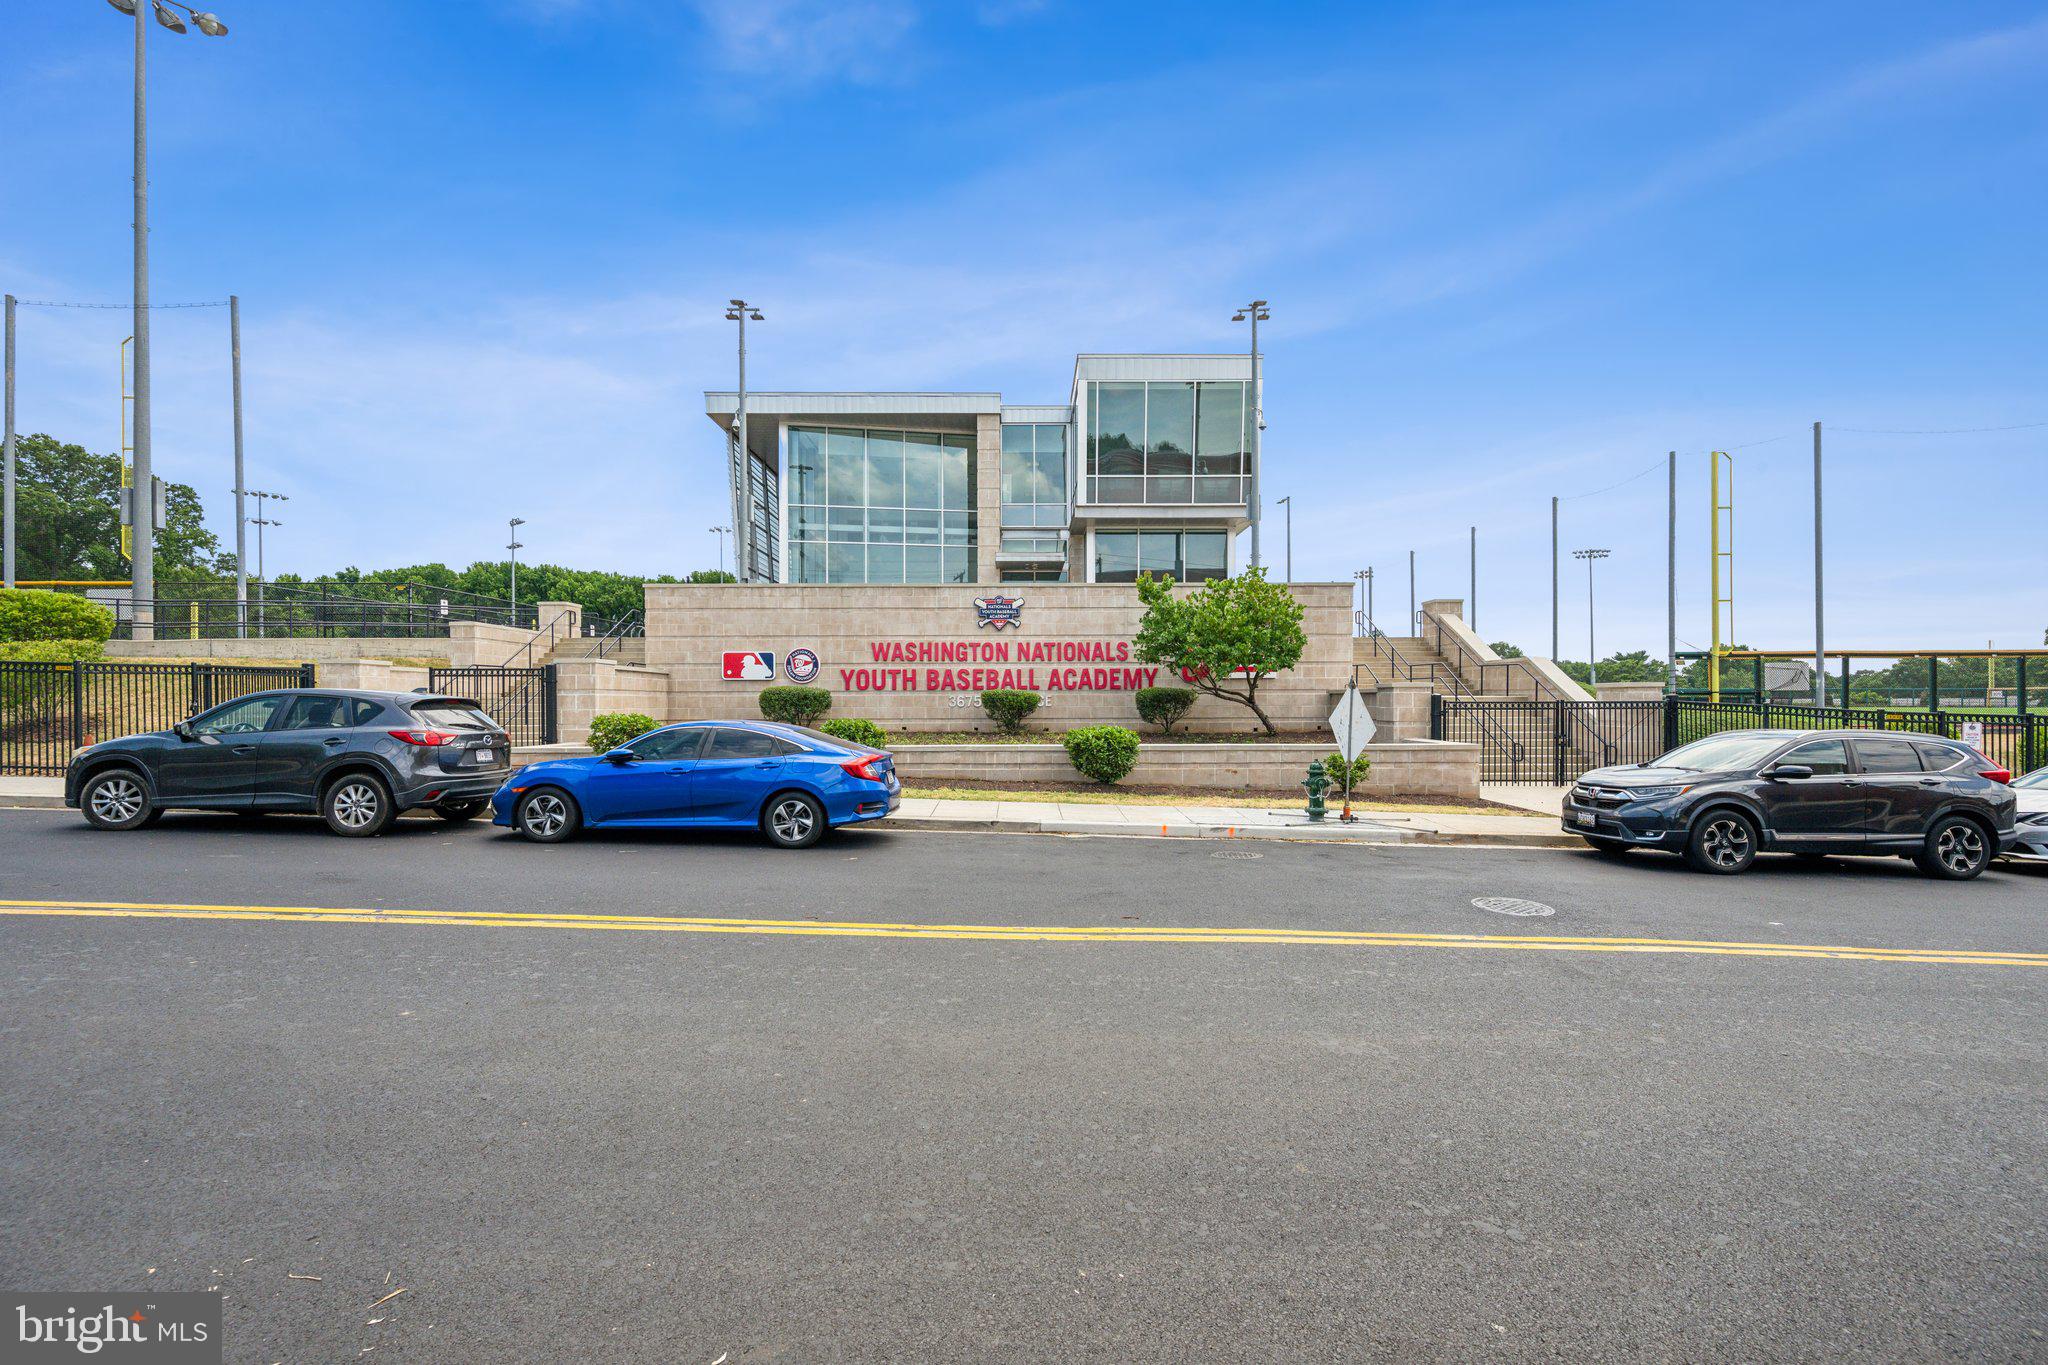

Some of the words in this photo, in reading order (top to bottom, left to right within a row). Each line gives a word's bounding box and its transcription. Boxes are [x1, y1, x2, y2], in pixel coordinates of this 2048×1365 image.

[872, 642, 1008, 662] WASHINGTON
[1018, 642, 1128, 662] NATIONALS
[840, 669, 917, 691] YOUTH
[926, 669, 1040, 690] BASEBALL
[1048, 668, 1158, 690] ACADEMY
[949, 695, 982, 708] 3675
